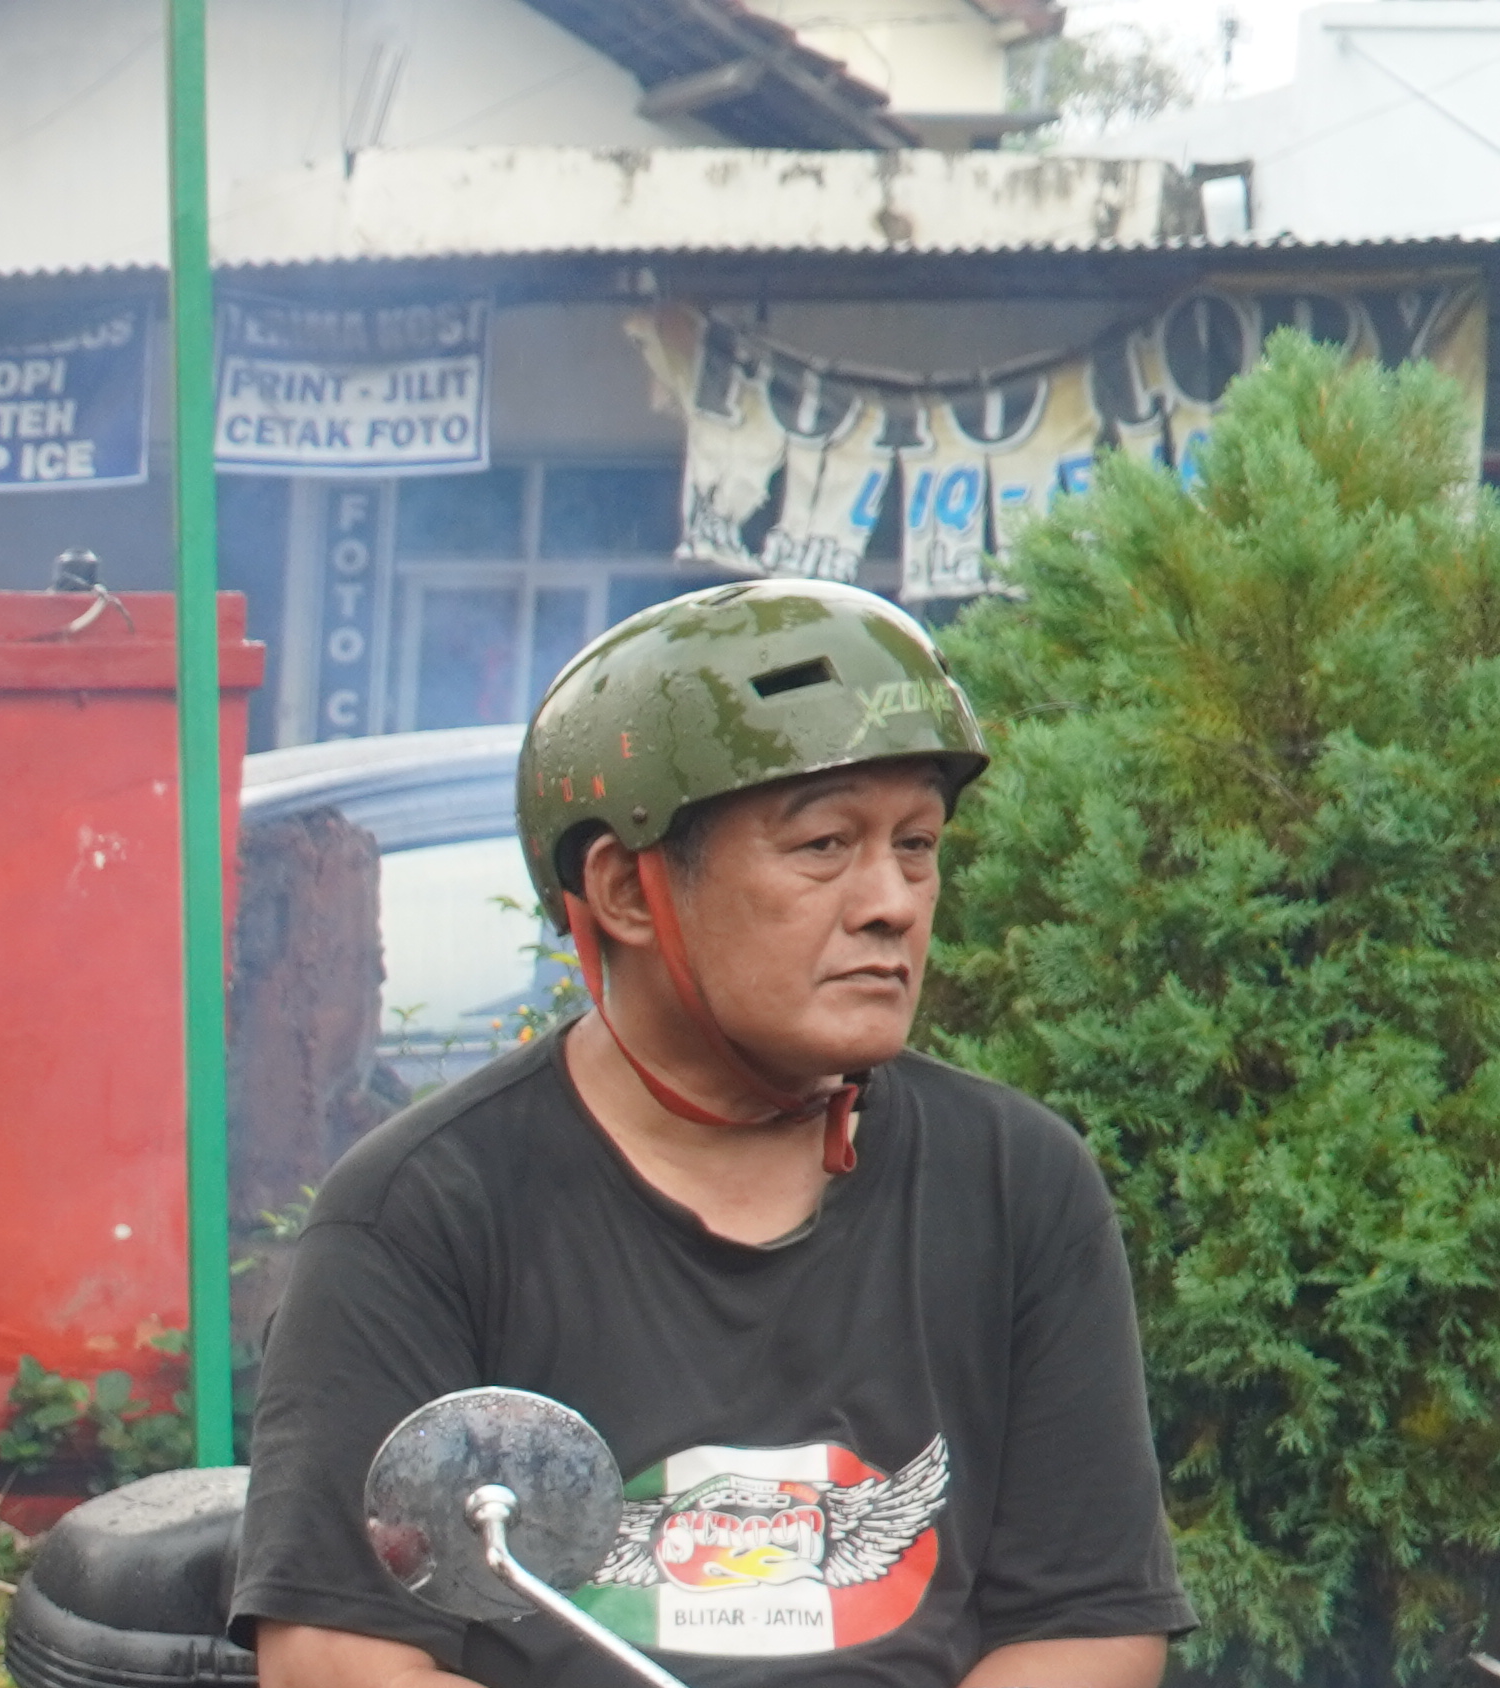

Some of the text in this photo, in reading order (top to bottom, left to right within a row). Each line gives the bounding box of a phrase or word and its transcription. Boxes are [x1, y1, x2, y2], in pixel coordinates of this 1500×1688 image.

[230, 368, 344, 402] PRINT
[383, 367, 470, 402] JILIT
[225, 414, 469, 449] CETAK FOTO
[20, 438, 97, 480] ICE
[326, 493, 370, 667] FOTO
[674, 1608, 746, 1627] BLITAR
[764, 1608, 824, 1627] JATIM
